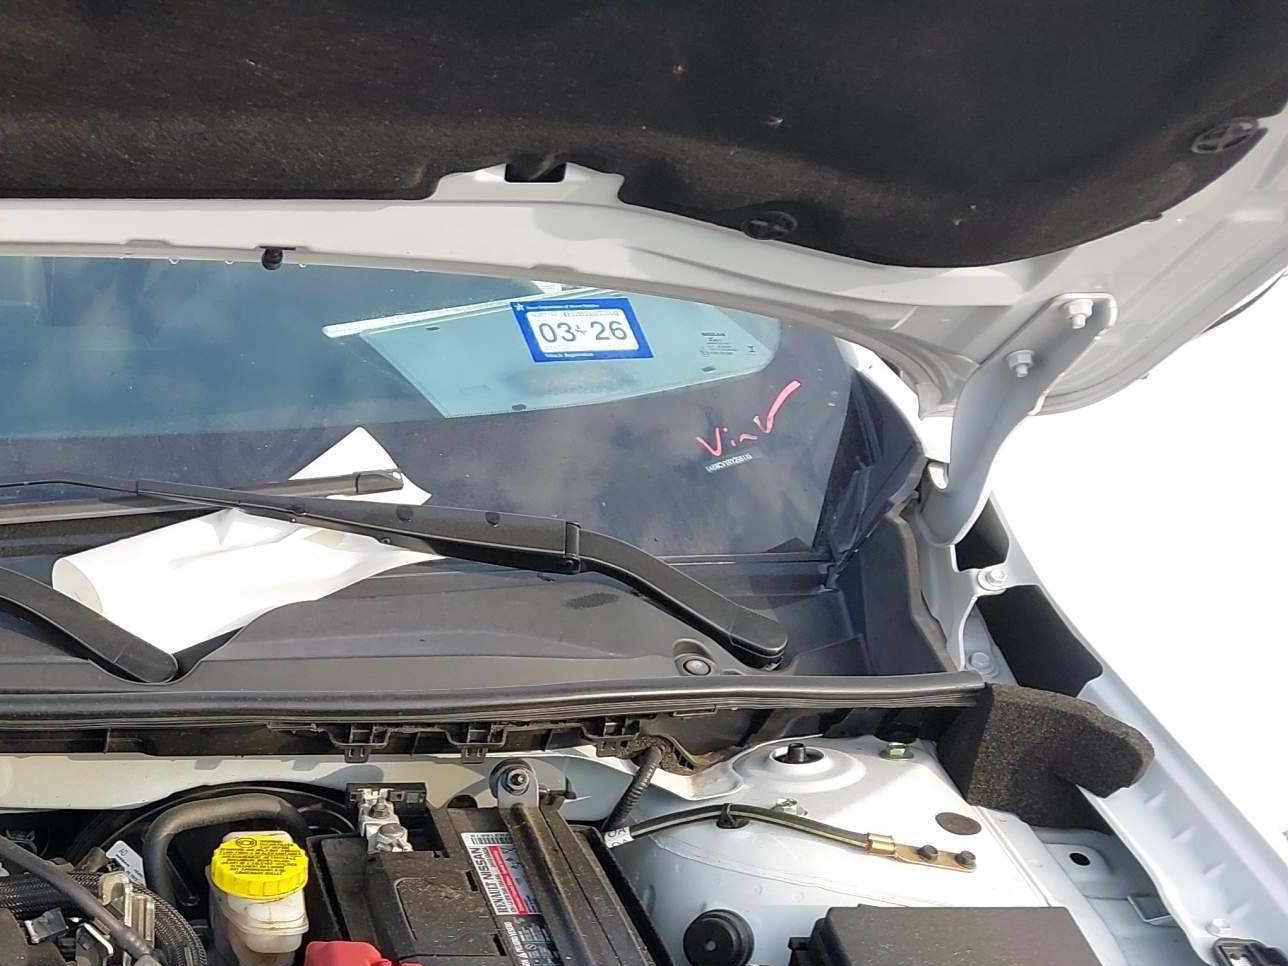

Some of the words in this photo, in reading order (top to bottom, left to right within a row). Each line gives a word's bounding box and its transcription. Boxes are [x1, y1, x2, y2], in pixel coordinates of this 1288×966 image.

[538, 322, 577, 343] 03
[590, 320, 628, 341] 26
[470, 847, 493, 880] NISSAN
